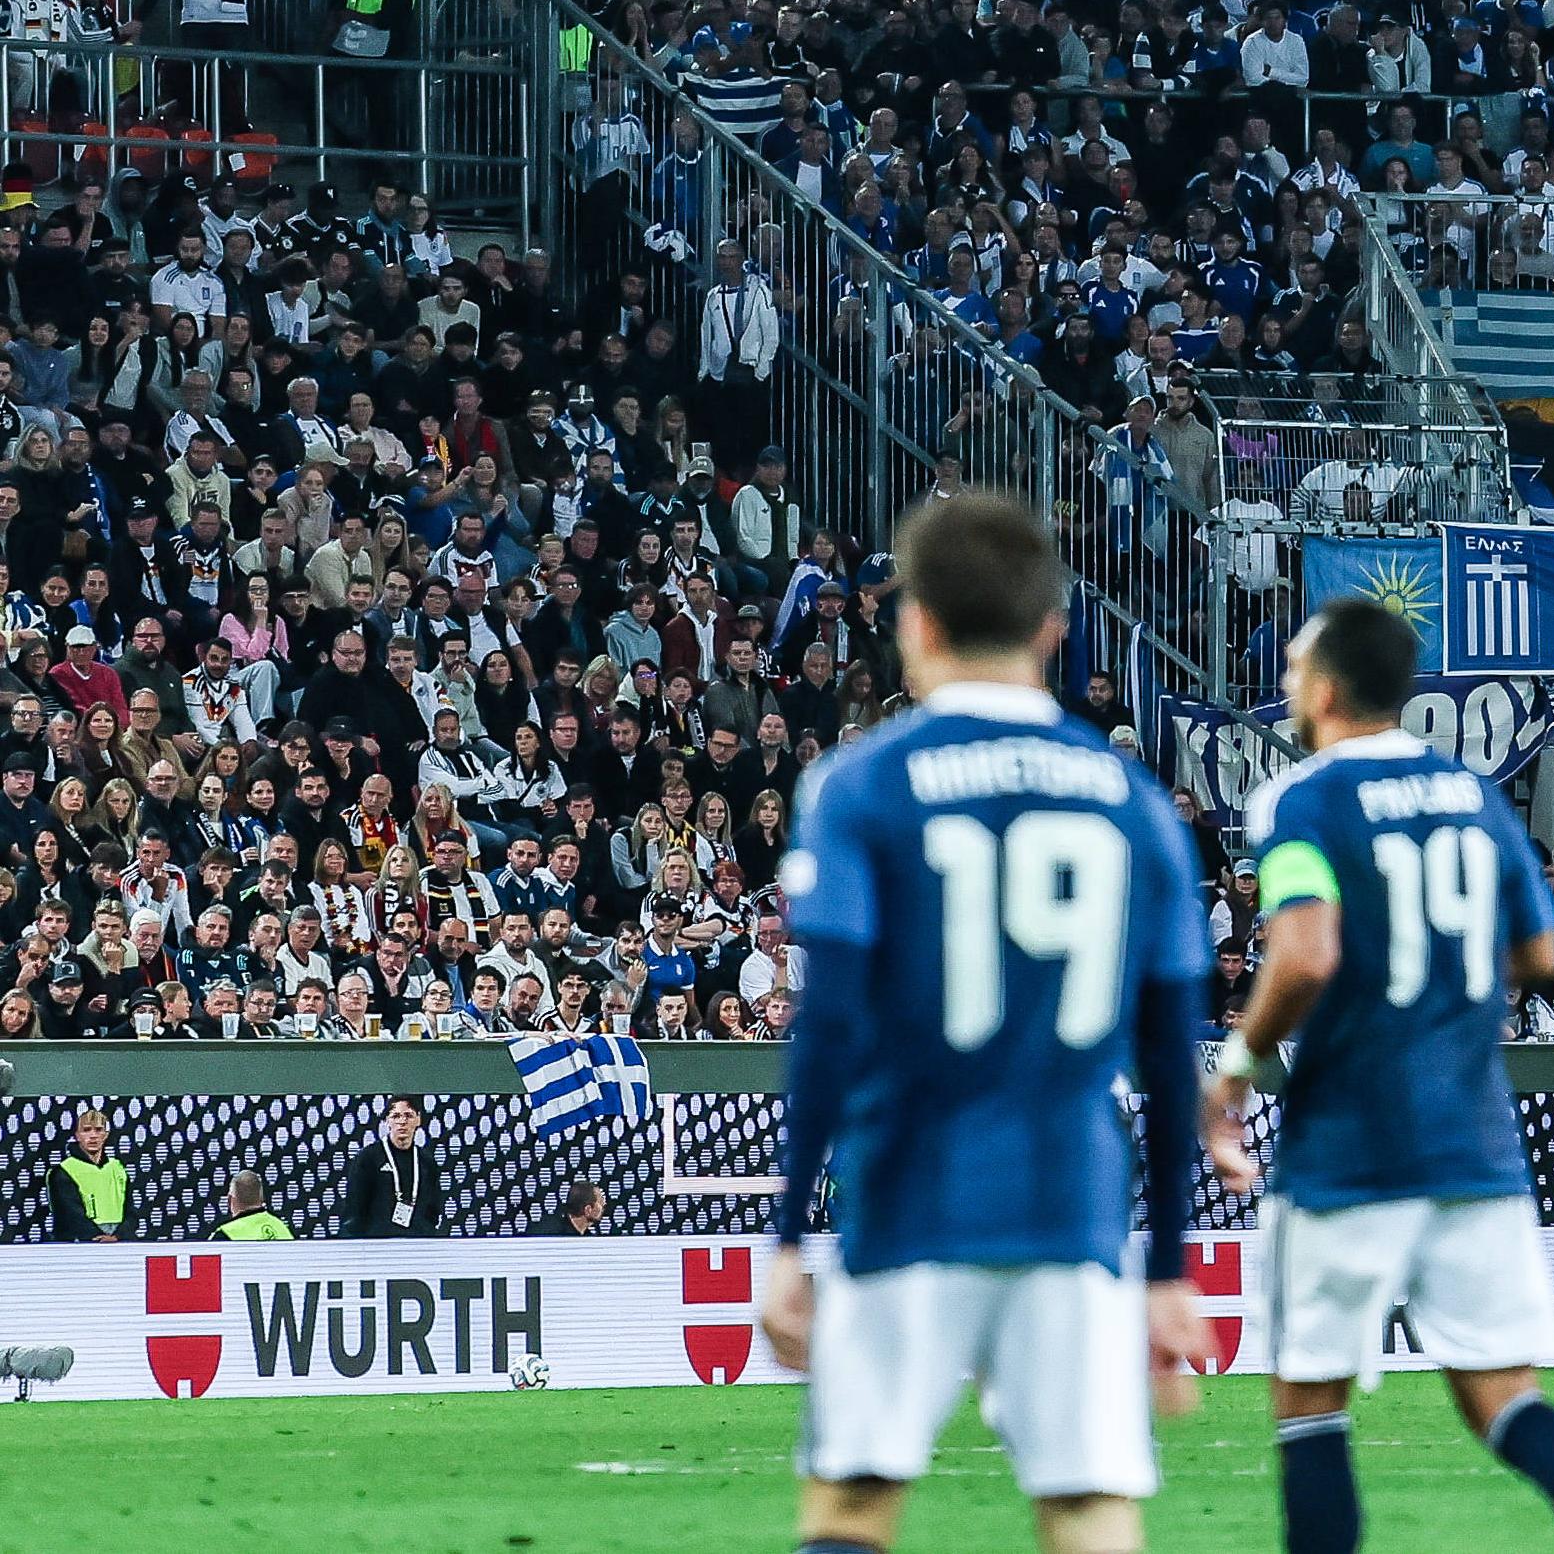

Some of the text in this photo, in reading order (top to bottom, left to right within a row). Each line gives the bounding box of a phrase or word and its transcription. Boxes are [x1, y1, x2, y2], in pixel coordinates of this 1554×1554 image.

[923, 809, 1131, 1054] 19
[1372, 824, 1499, 1009] 14
[243, 1276, 542, 1378] WÜRTH
